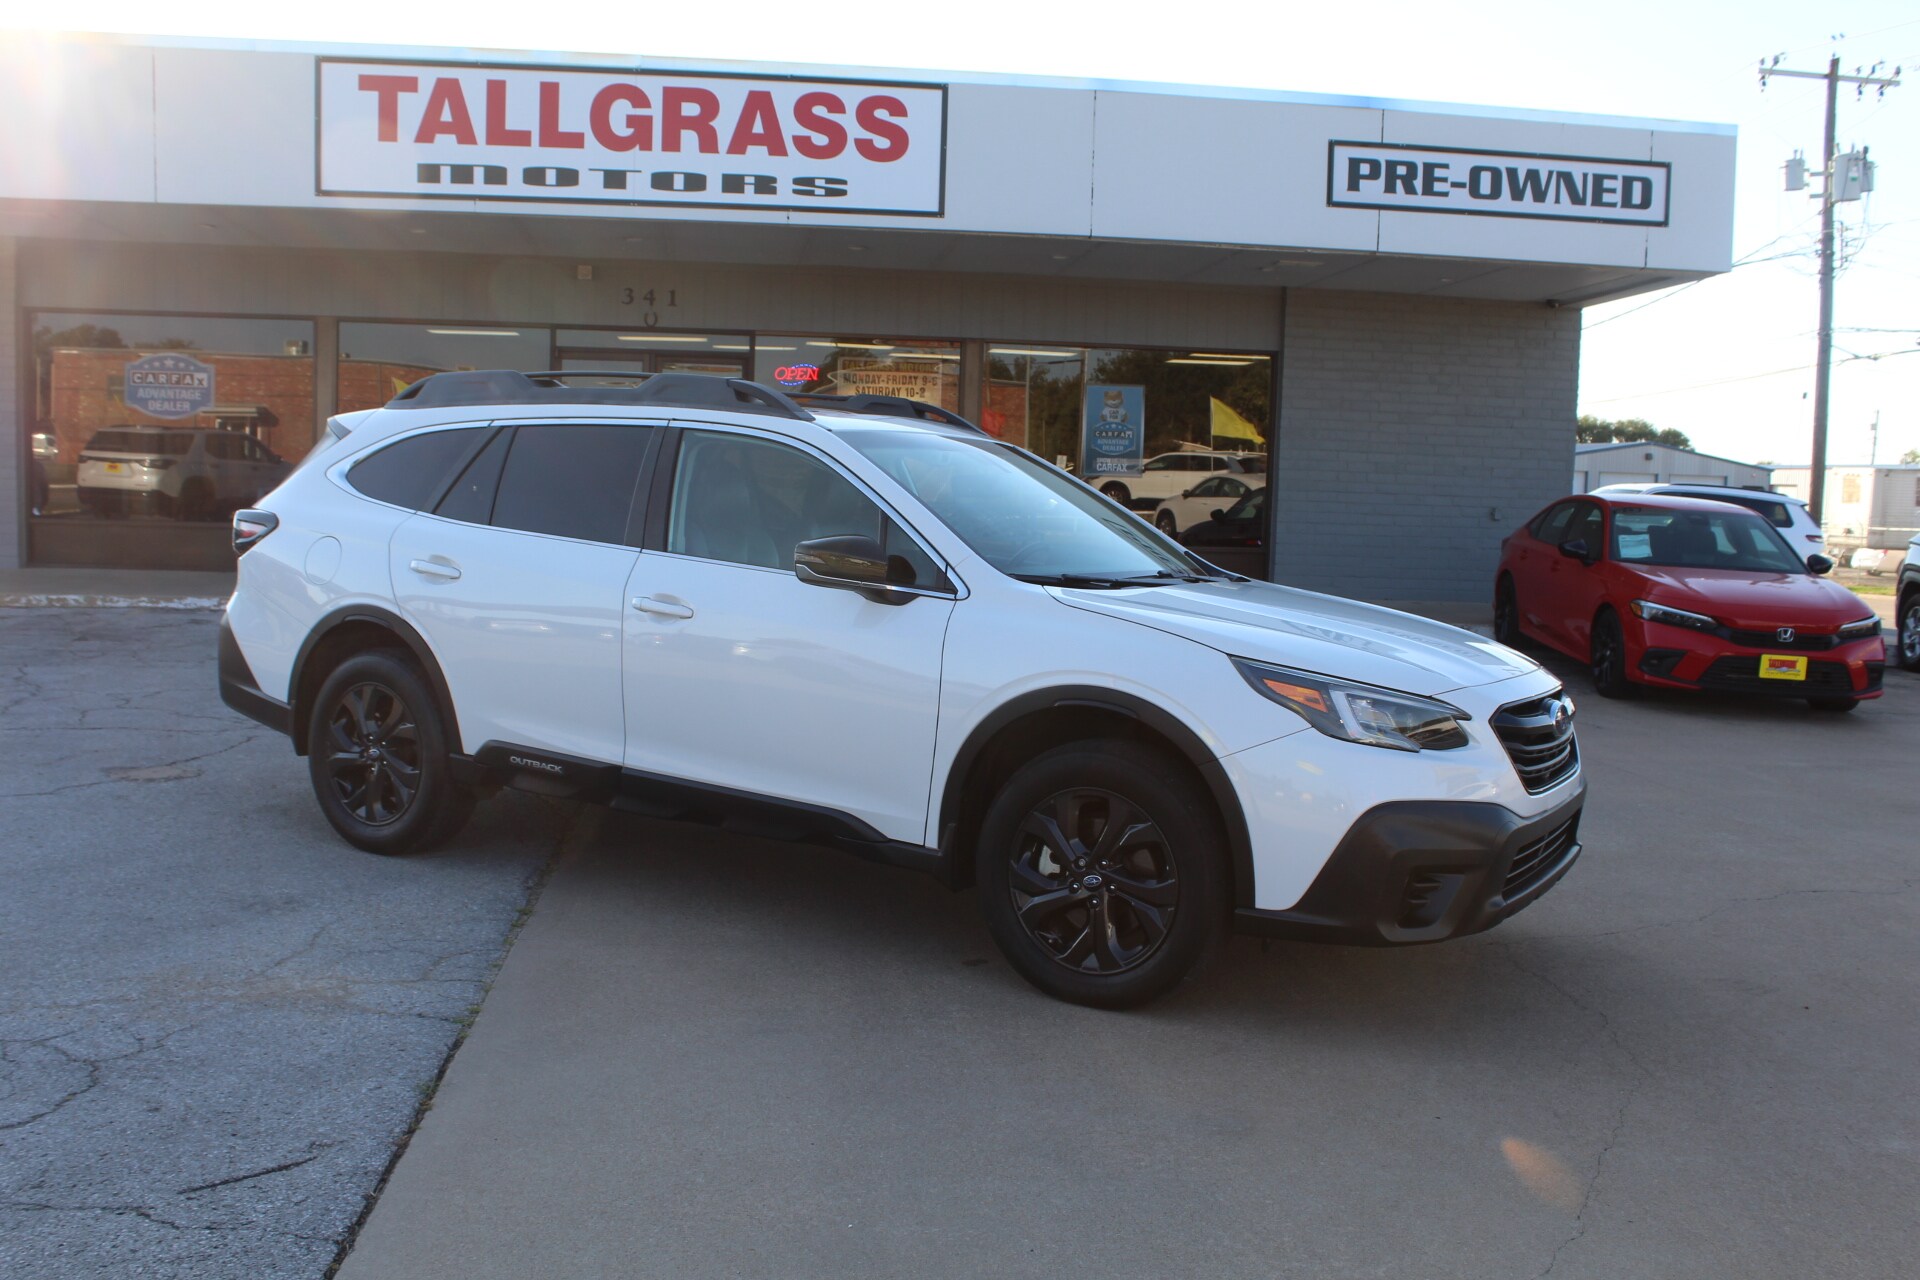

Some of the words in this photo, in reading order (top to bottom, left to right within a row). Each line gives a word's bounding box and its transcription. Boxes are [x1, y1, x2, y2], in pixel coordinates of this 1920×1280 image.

[357, 73, 910, 163] TALLGRASS
[416, 162, 848, 198] MOTORS
[1346, 156, 1654, 211] PRE-OWNED
[132, 373, 207, 386] CARFAX
[774, 366, 820, 381] OPEN
[843, 373, 918, 386] MONDAY-FRIDAY
[136, 387, 202, 400] ADVANTAGE
[855, 386, 901, 397] SATURDAY
[905, 387, 926, 398] 10-2
[148, 400, 191, 411] DEALER
[1096, 463, 1127, 472] CARFAX
[509, 755, 563, 773] OUTBACK
